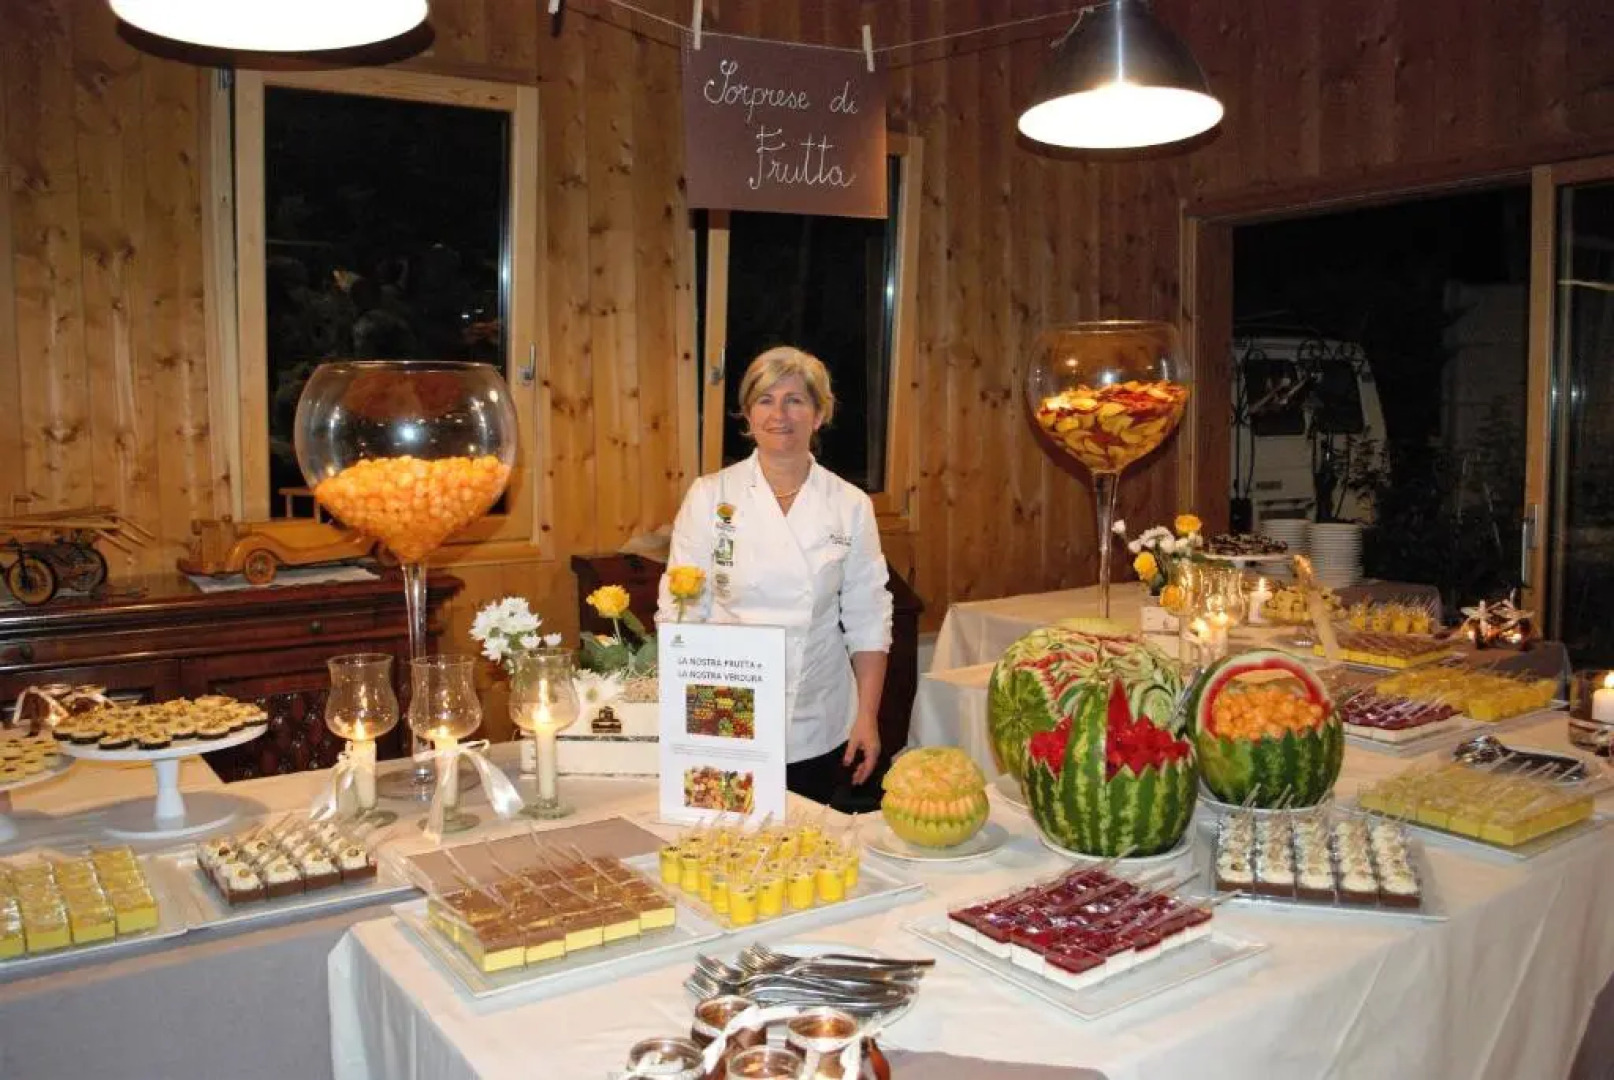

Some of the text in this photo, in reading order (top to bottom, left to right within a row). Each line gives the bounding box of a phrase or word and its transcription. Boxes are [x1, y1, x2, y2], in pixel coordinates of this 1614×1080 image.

[704, 59, 858, 124] Sorprese di
[748, 125, 857, 190] Frutta
[677, 657, 688, 665] LA
[690, 658, 722, 667] NOSTRA
[724, 660, 755, 669] FRUTTA
[677, 669, 763, 682] LA NOSTRA VERDURA
